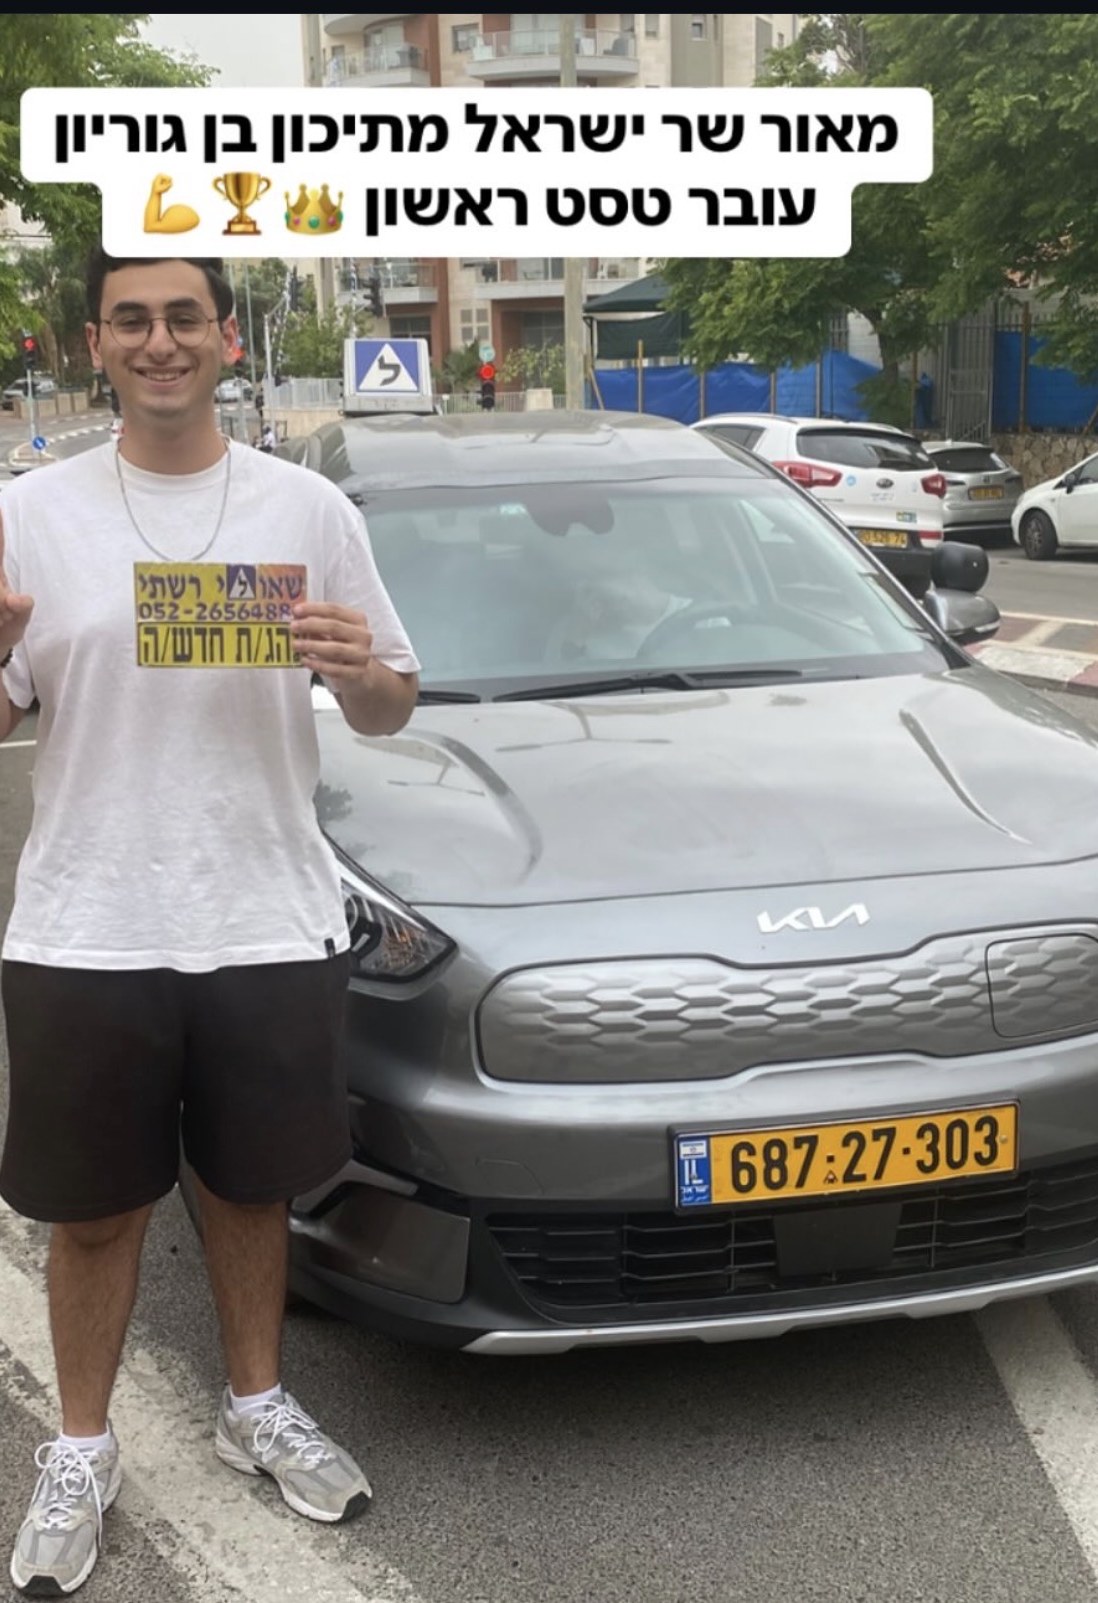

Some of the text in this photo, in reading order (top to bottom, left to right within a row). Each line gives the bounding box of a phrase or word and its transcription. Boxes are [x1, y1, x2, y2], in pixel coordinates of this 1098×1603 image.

[377, 354, 401, 387] ל
[138, 573, 201, 599] רשתי
[143, 626, 300, 663] הג/ת חדש/ה
[757, 903, 870, 933] KIA
